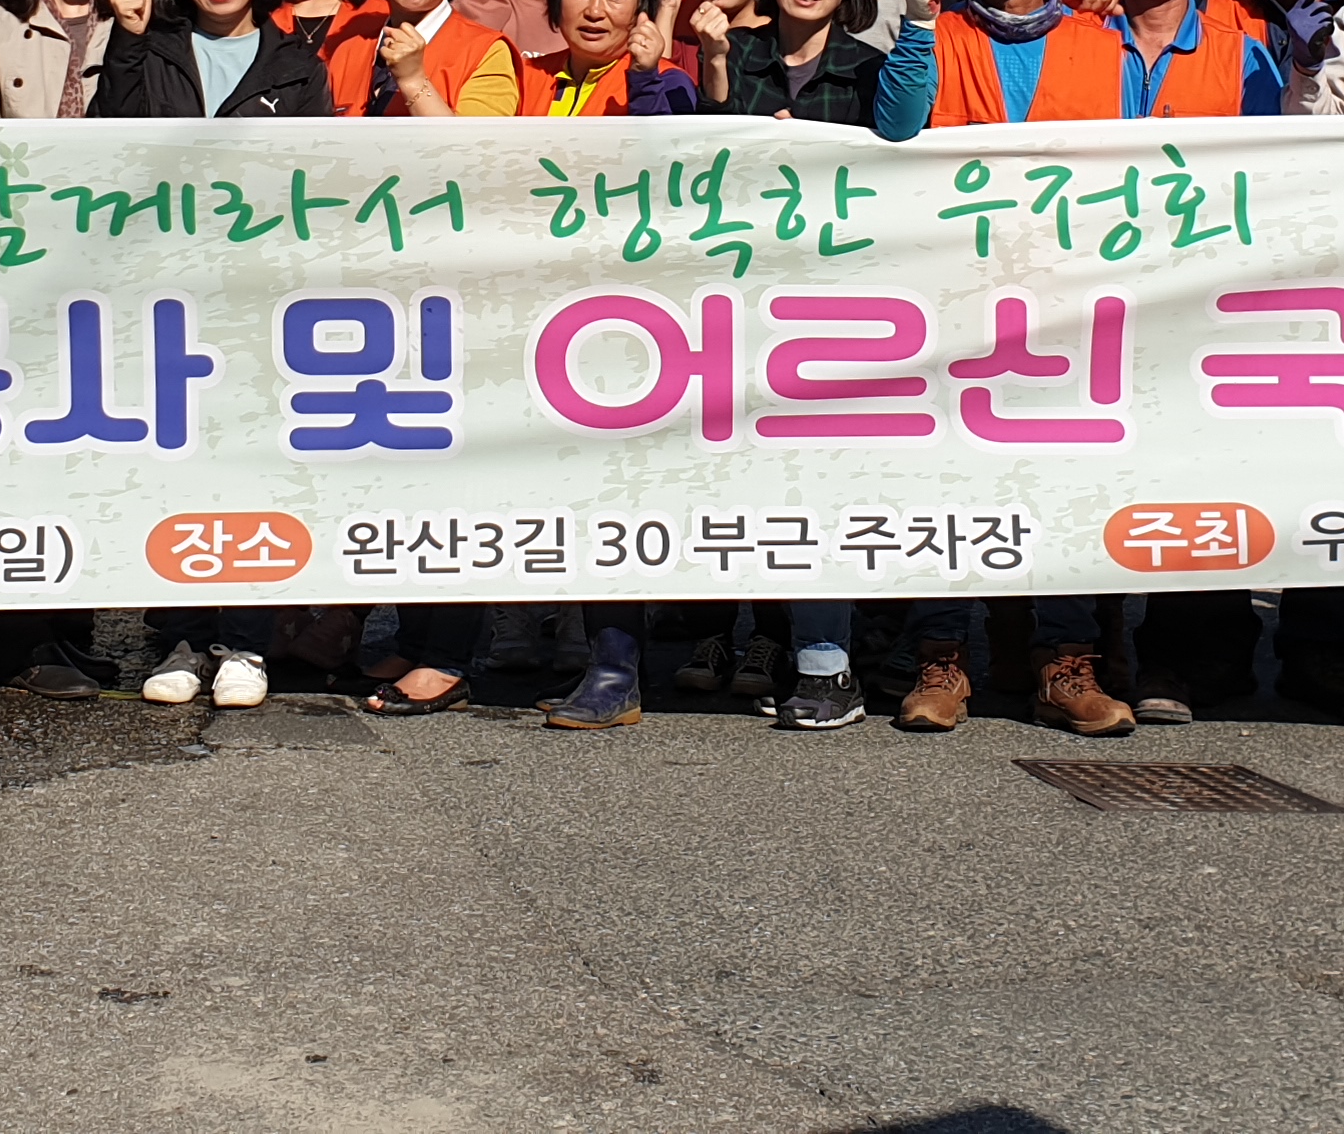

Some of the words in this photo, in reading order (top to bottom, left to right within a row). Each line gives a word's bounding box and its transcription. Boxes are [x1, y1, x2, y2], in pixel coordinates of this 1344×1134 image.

[533, 149, 876, 278] 행복한
[939, 145, 1251, 260] 우정회
[286, 300, 452, 450] 및
[538, 296, 1125, 442] 어르신
[171, 520, 301, 578] 장소
[343, 518, 566, 574] 완산3길
[596, 522, 669, 566] 30
[694, 516, 818, 570] 부근
[841, 515, 1030, 569] 주차장
[1124, 509, 1247, 566] 주최
